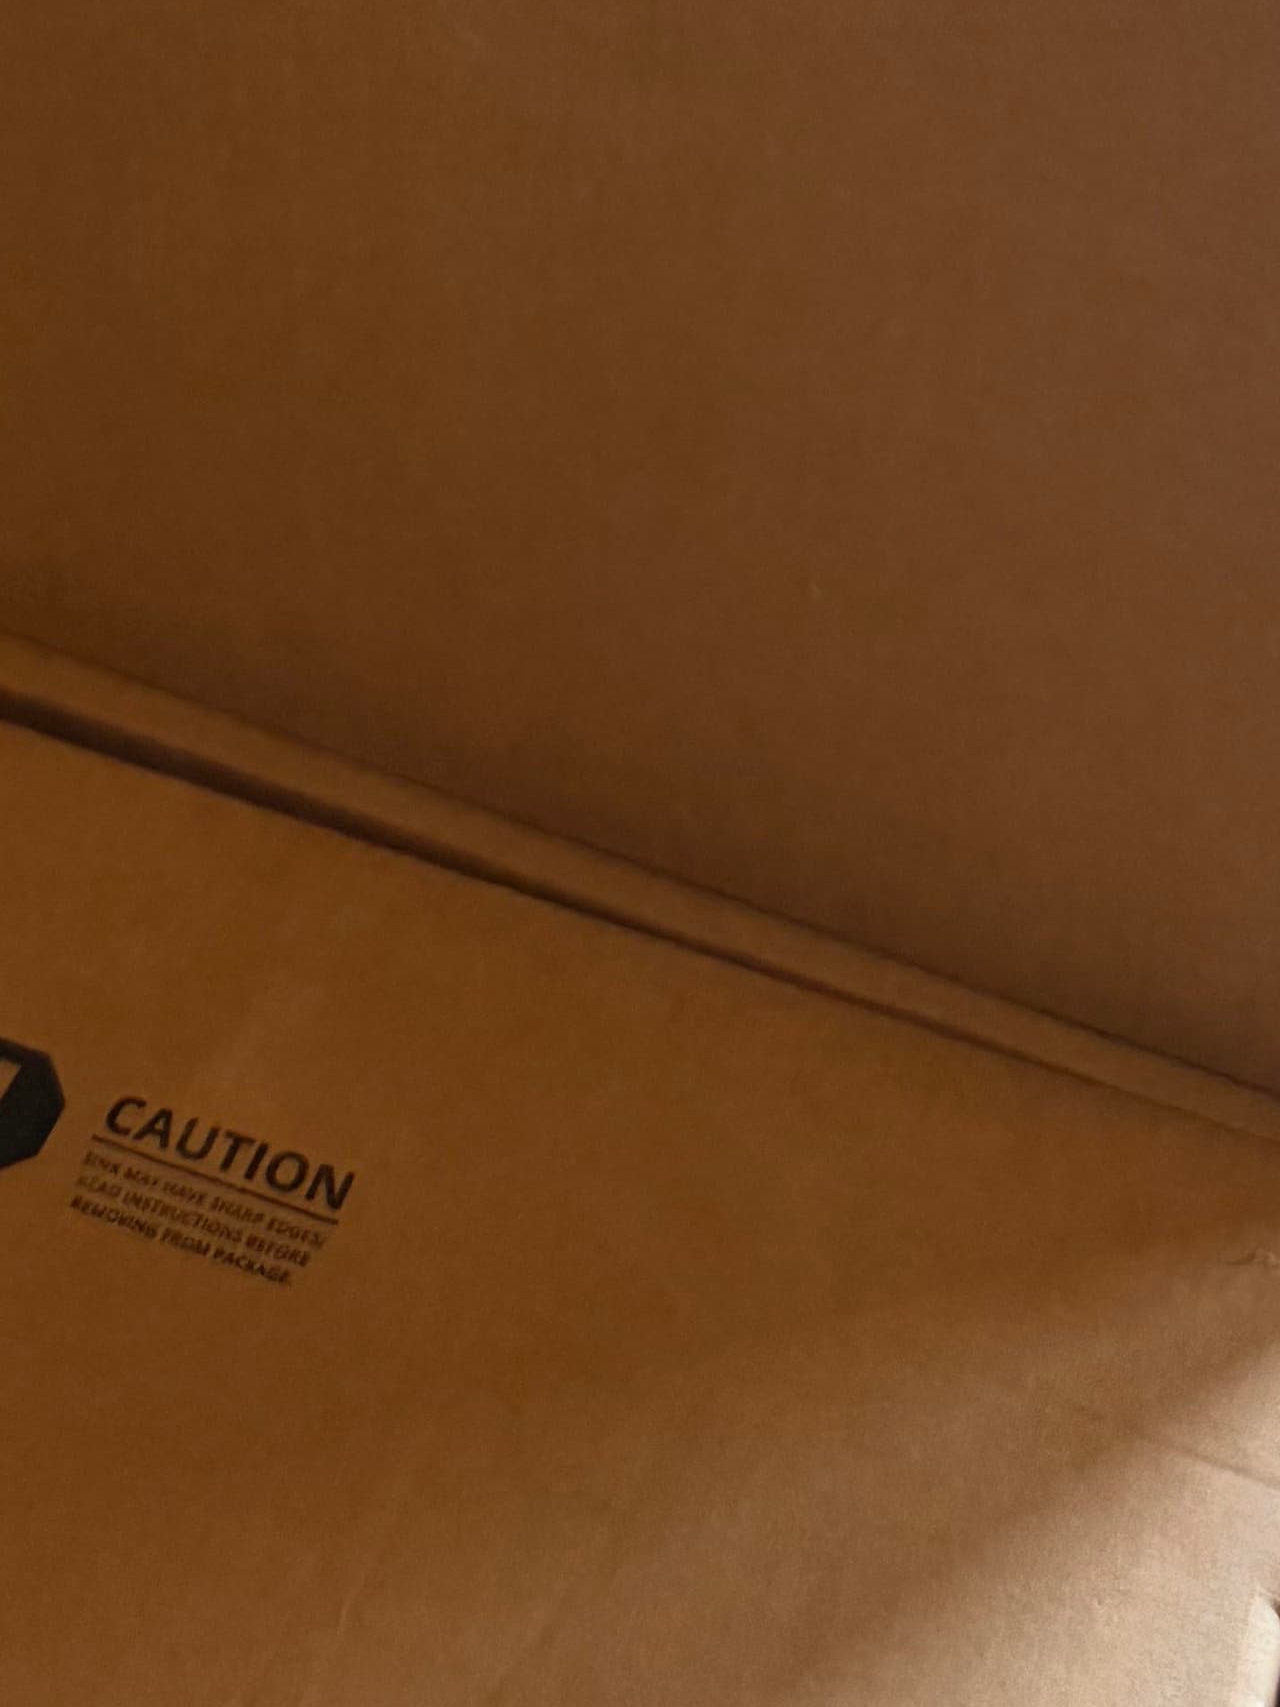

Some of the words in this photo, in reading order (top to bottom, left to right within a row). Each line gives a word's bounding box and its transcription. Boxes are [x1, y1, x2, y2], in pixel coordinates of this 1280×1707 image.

[105, 1095, 356, 1210] CAUTION
[70, 1194, 158, 1240] REMOVING
[160, 1226, 211, 1257] FROM
[123, 1191, 243, 1244] INSTRUCTIONS
[245, 1232, 311, 1267] BEFORE
[211, 1195, 265, 1224] SHARP
